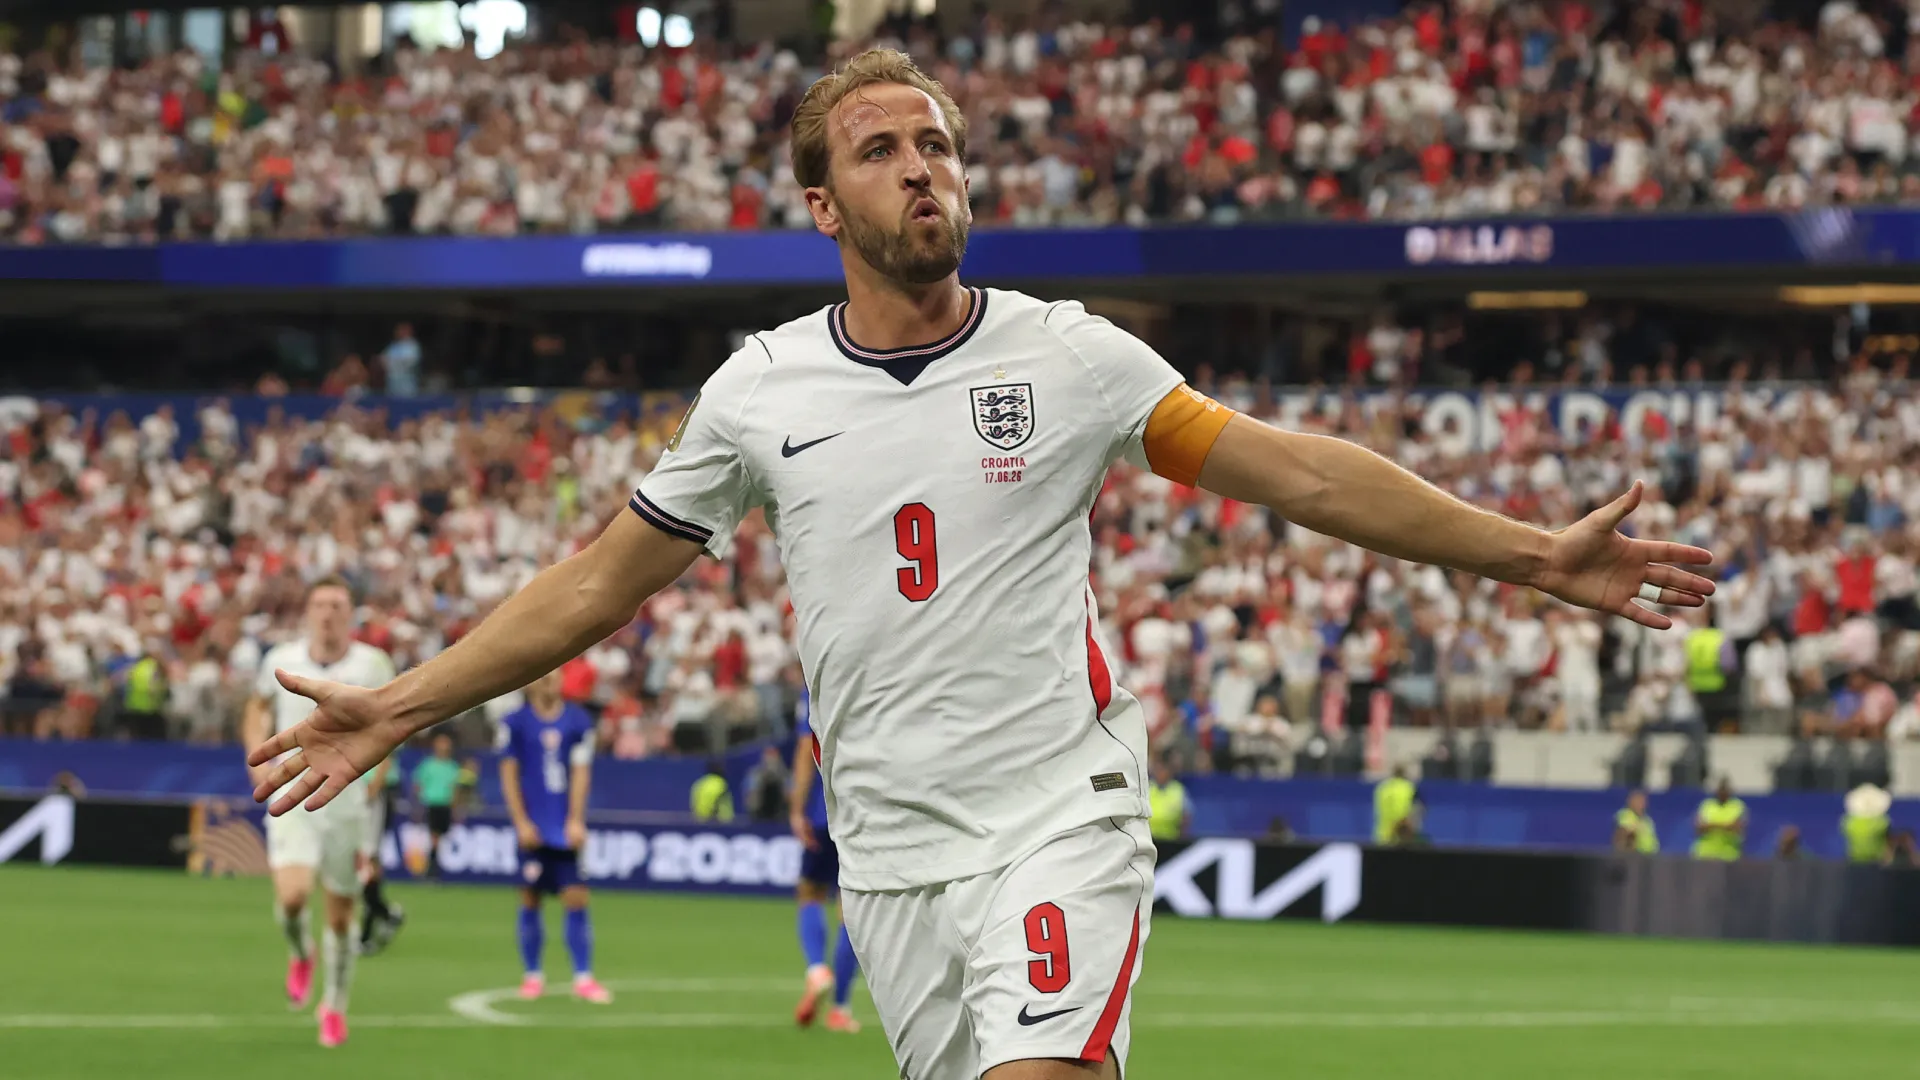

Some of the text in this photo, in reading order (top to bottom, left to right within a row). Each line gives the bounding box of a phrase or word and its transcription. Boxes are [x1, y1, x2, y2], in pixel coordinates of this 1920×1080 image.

[981, 457, 1026, 469] CROATIA
[985, 470, 1022, 484] 17.06.26
[893, 502, 939, 602] 9
[1023, 901, 1071, 994] 9
